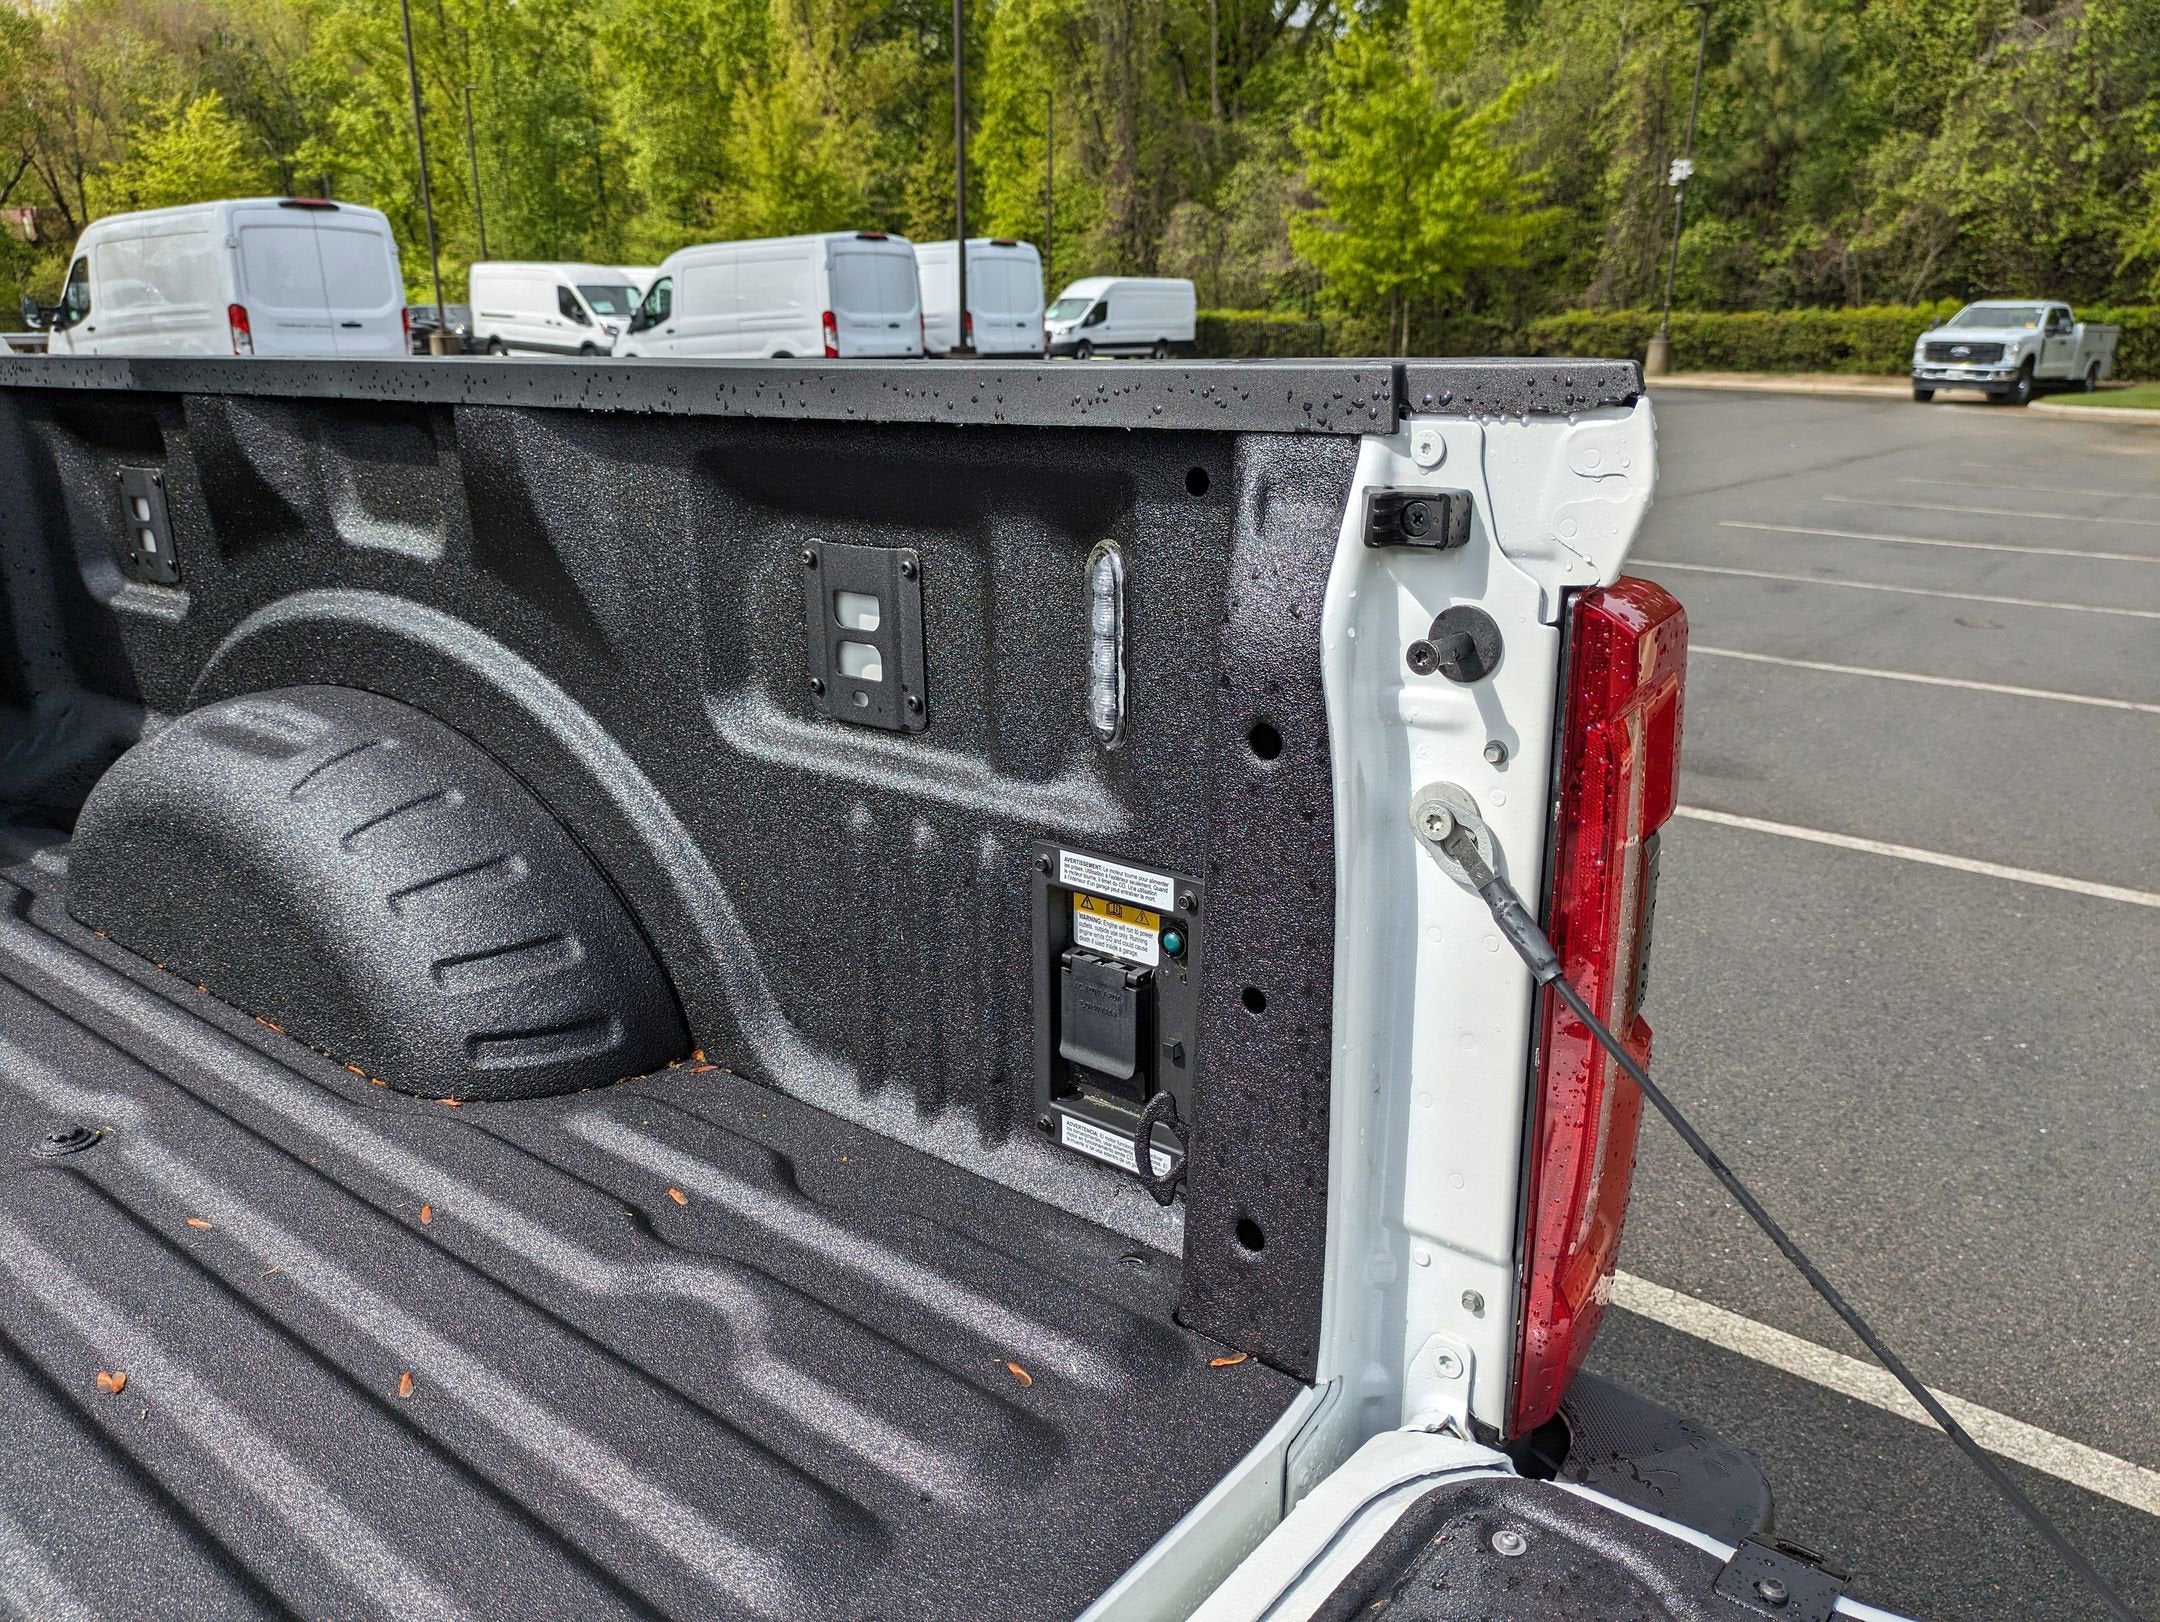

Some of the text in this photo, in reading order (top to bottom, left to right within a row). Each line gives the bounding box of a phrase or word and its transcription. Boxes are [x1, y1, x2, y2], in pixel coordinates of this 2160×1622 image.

[1064, 856, 1101, 870] AVERTISSEMENT:
[1138, 875, 1147, 884] pour
[1149, 877, 1168, 887] alimenter
[1153, 884, 1168, 893] Quand
[1078, 913, 1101, 924] WARNING:
[1103, 919, 1117, 930] Engine
[1139, 930, 1153, 939] power
[1094, 925, 1109, 934] outside
[1129, 933, 1147, 946] Running
[1079, 928, 1092, 937] engine
[1122, 940, 1133, 948] could
[1134, 944, 1147, 952] cause
[1079, 934, 1090, 942] death
[1095, 939, 1104, 947] used
[1105, 942, 1117, 951] inside
